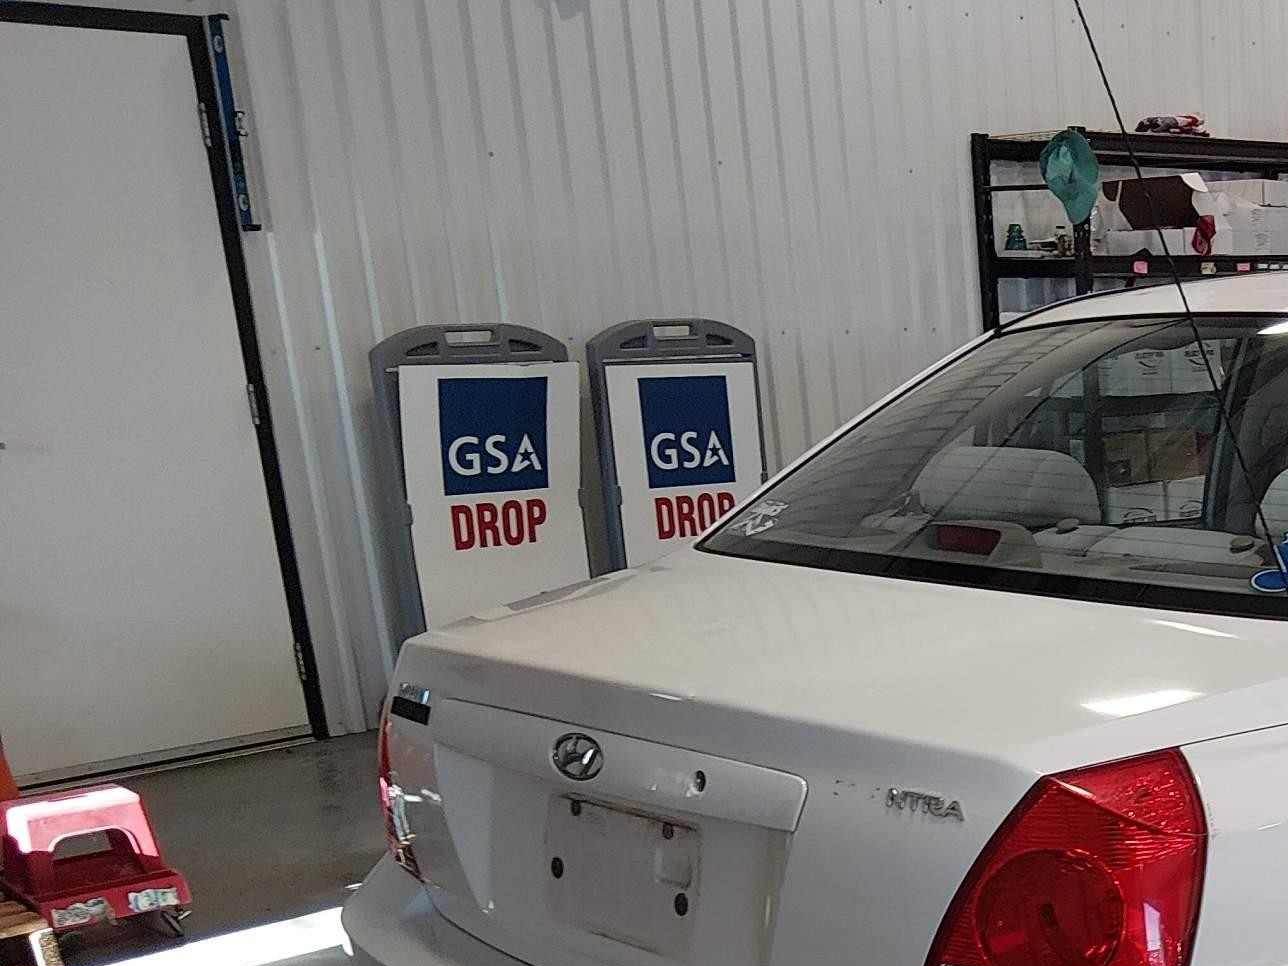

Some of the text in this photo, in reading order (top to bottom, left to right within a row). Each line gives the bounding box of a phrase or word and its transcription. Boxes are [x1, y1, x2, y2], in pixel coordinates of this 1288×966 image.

[448, 433, 543, 477] GSA
[650, 429, 730, 471] GSA
[450, 498, 547, 551] DROP
